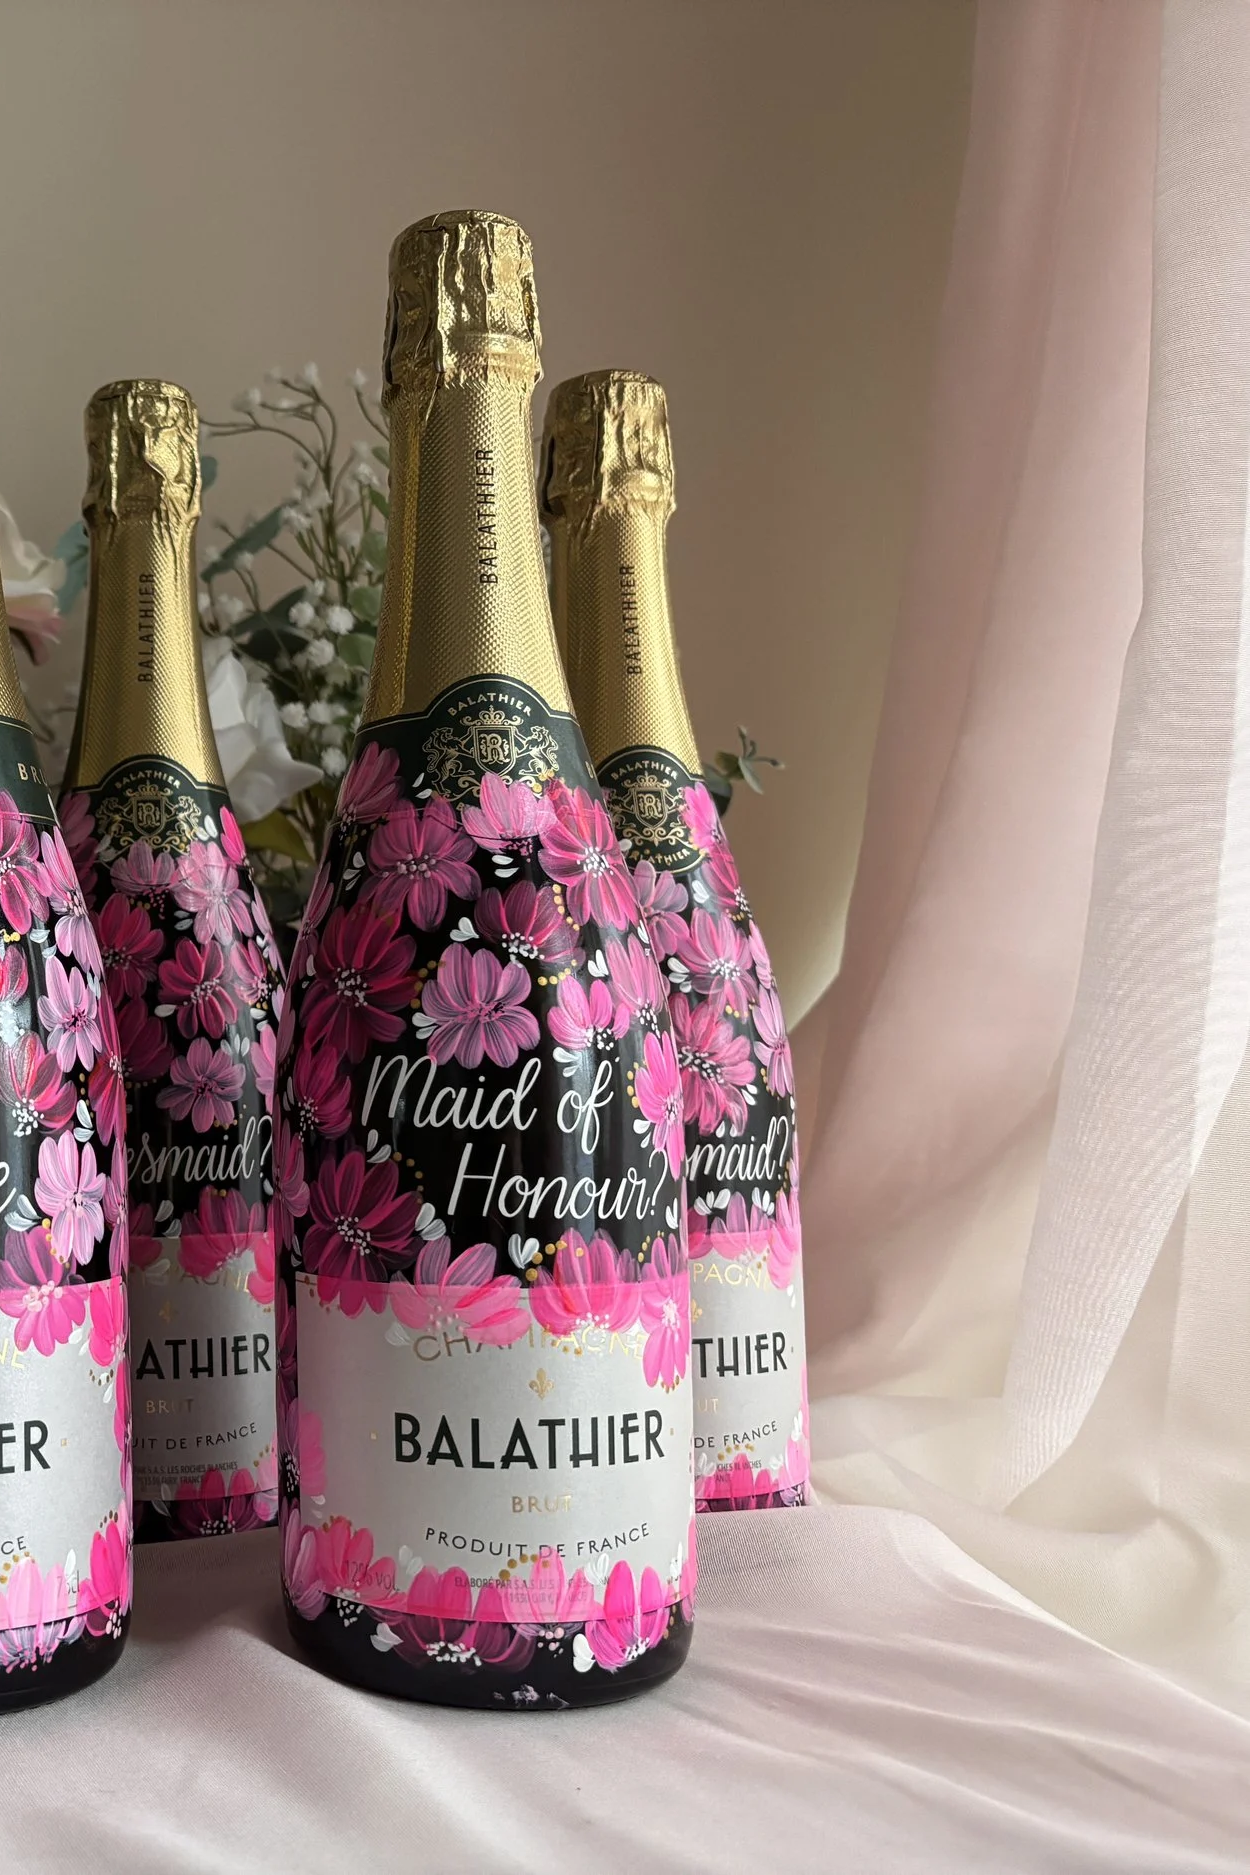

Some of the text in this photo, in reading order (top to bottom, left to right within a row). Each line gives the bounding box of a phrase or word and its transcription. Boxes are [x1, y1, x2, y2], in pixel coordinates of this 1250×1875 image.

[475, 449, 498, 583] BALATHIER
[137, 573, 155, 682] BALATHIER
[619, 566, 642, 674] BALATHIER
[447, 692, 532, 717] BALATHIER
[114, 769, 181, 789] BALATHIER
[610, 760, 678, 780] BALATHIER
[360, 1054, 614, 1155] Maid of
[447, 1142, 668, 1221] Honour?
[136, 1333, 272, 1380] ATHIER
[692, 1331, 788, 1378] THIER
[166, 1438, 188, 1450] DE
[196, 1422, 257, 1448] FRANCE
[394, 1409, 665, 1469] BALATHIER
[694, 1420, 778, 1448] DE FRANCE
[511, 1494, 573, 1514] BRUT
[426, 1522, 650, 1558] PRODUIT DE FRANCE
